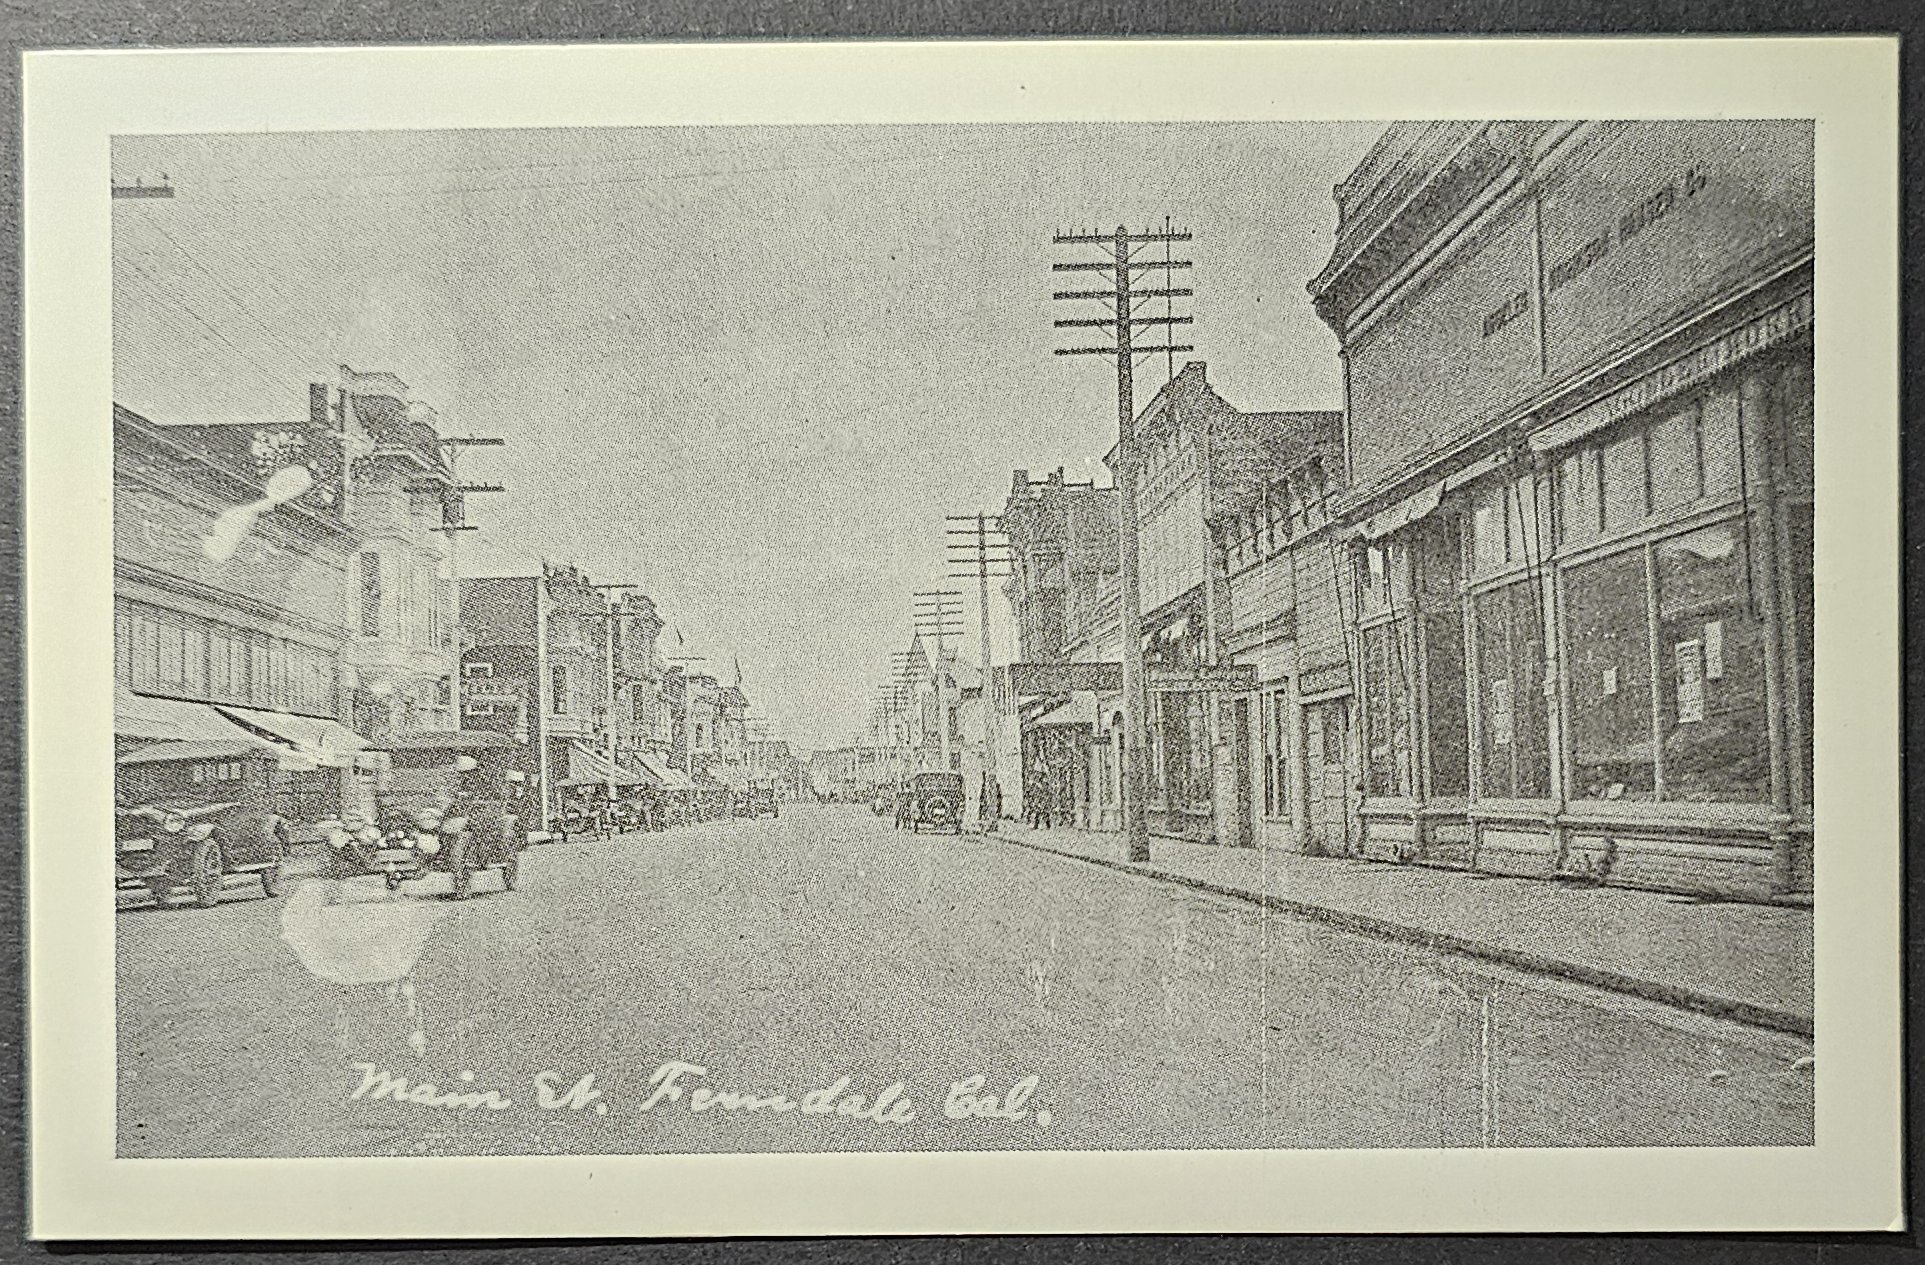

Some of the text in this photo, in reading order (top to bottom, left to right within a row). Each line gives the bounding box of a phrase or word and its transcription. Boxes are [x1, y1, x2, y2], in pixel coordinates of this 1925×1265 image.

[351, 1060, 1051, 1127] Main St. Ferndale Cal.
